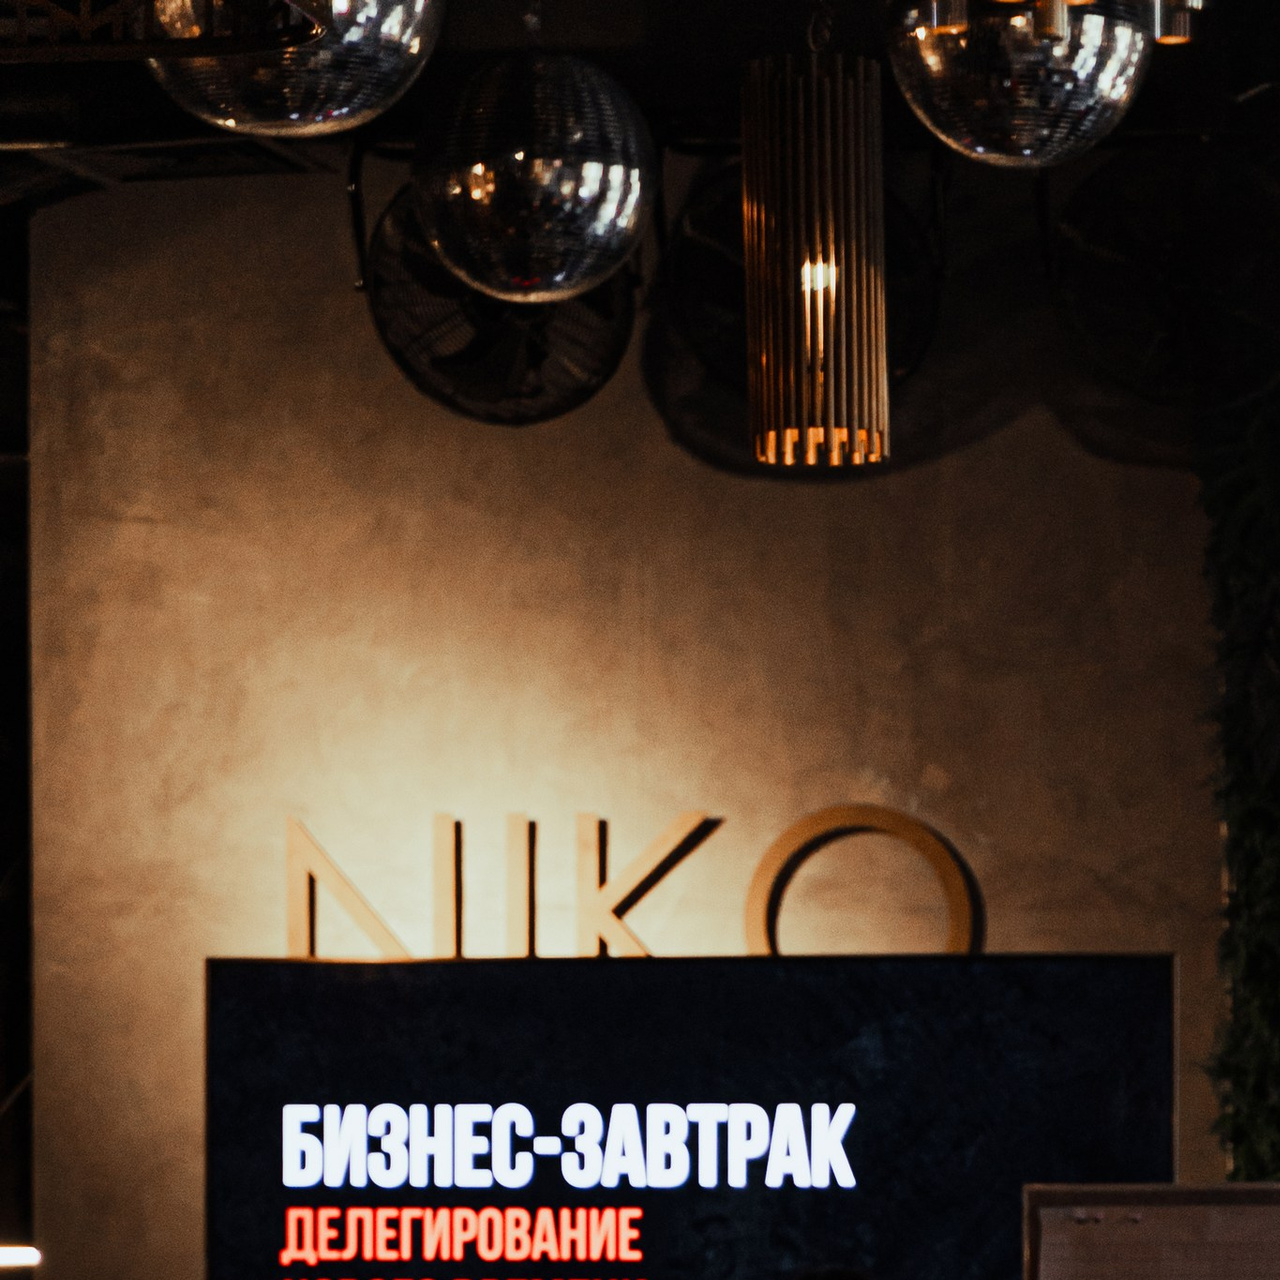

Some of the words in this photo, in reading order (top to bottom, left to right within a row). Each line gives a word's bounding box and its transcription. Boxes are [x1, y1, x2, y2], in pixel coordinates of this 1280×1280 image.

[286, 803, 978, 958] NIKO
[281, 1102, 857, 1189] БИЗНЕС-ЗАВТРАК
[279, 1206, 644, 1266] ДЕЛЕГИРОВАНИЕ
